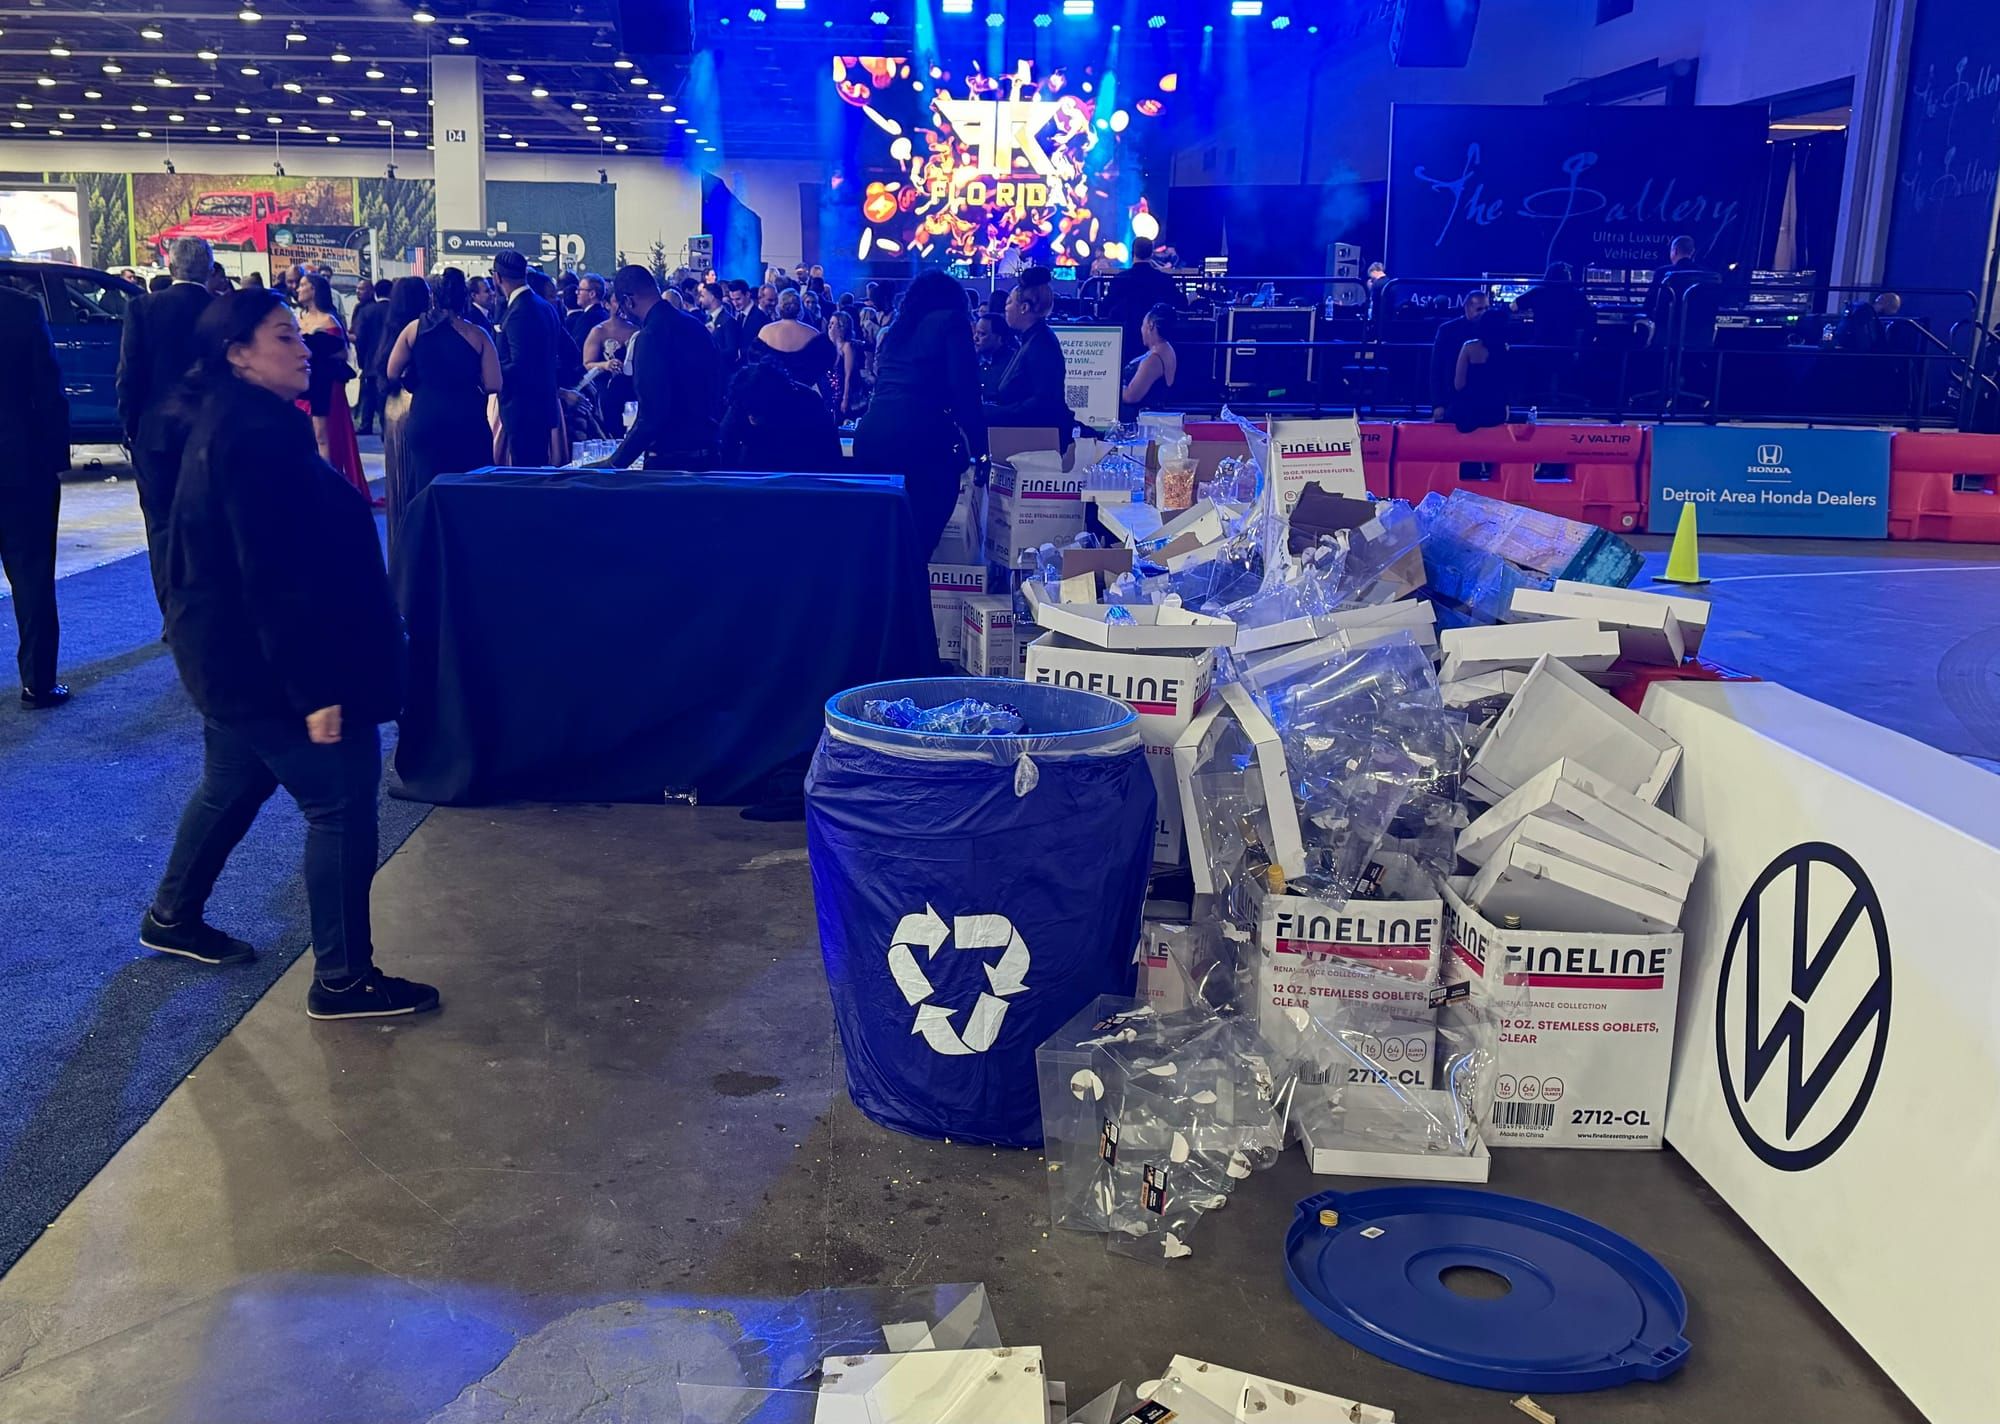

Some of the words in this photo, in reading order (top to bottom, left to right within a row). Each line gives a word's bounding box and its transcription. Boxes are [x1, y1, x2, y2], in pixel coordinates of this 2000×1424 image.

[448, 130, 463, 142] D4
[1414, 142, 1503, 246] The
[1517, 152, 1738, 275] Gallery
[465, 240, 515, 248] ARTICULATION
[1592, 231, 1626, 243] Ultra
[1629, 232, 1674, 246] Luxury
[1604, 248, 1658, 260] Vehicles
[1587, 434, 1632, 443] VALTIR
[1281, 442, 1352, 453] FINELINE
[1747, 466, 1792, 474] HONDA
[1022, 480, 1087, 492] FINELINE
[1663, 487, 1715, 503] Detroit
[1720, 489, 1756, 502] Area
[1761, 489, 1812, 504] Honda
[1817, 491, 1877, 506] Dealers
[931, 572, 983, 585] NELINE
[991, 615, 1012, 624] FINE
[947, 640, 961, 648] 271
[1036, 668, 1179, 702] FINELINE
[1146, 745, 1173, 756] LETS,
[1276, 913, 1432, 943] FINELINE
[1505, 946, 1666, 974] FINELINE
[1327, 970, 1376, 980] COLLECTION
[1272, 984, 1284, 992] 12
[1287, 985, 1307, 995] OZ.
[1309, 986, 1369, 999] STEMLESS
[1372, 991, 1427, 1002] GOBLETS,
[1272, 997, 1309, 1008] CLEAR
[1500, 1019, 1511, 1028] 12
[1514, 1020, 1534, 1030] OZ.
[1538, 1020, 1600, 1031] STEMLESS
[1603, 1022, 1659, 1033] GOBLETS,
[1499, 1033, 1537, 1044] CLEAR
[1366, 1045, 1376, 1053] 16
[1386, 1045, 1399, 1054] 64
[1348, 1069, 1425, 1086] 2712-CL
[1500, 1082, 1511, 1092] 16
[1522, 1083, 1535, 1093] 64
[1571, 1109, 1651, 1126] 2712-CL
